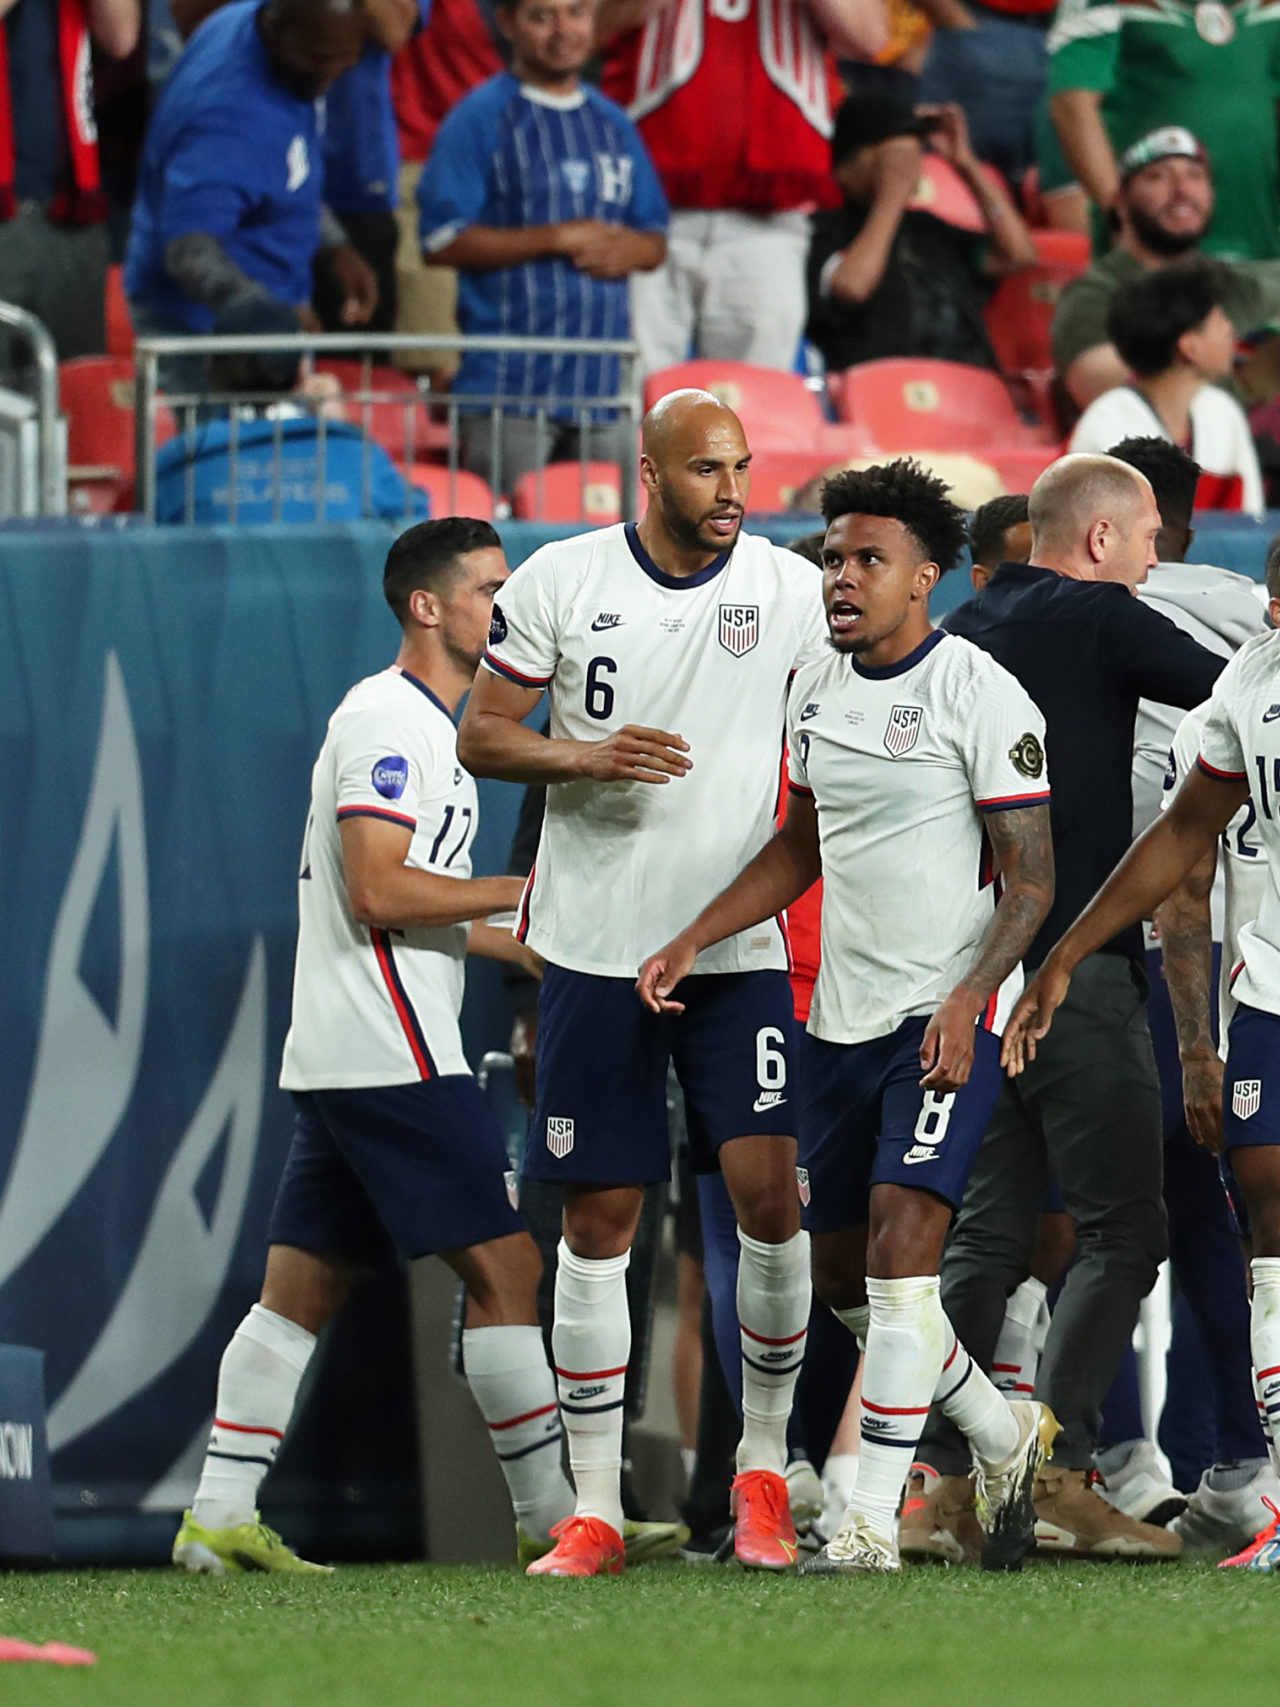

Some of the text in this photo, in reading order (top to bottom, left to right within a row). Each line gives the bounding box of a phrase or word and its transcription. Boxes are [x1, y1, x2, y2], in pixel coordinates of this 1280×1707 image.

[597, 613, 622, 625] NIKE
[723, 608, 755, 627] USA
[585, 656, 617, 720] 6
[893, 708, 918, 729] USA
[1222, 796, 1258, 857] 2
[427, 805, 471, 867] 17
[756, 1027, 787, 1090] 6
[758, 1092, 783, 1104] NIKE
[1235, 1082, 1259, 1097] USA
[914, 1090, 957, 1145] 8
[549, 1118, 573, 1136] USA
[909, 1144, 936, 1156] NIKE
[766, 1350, 794, 1360] NIKE
[576, 1384, 607, 1395] NIKE
[862, 1415, 890, 1428] NIKE
